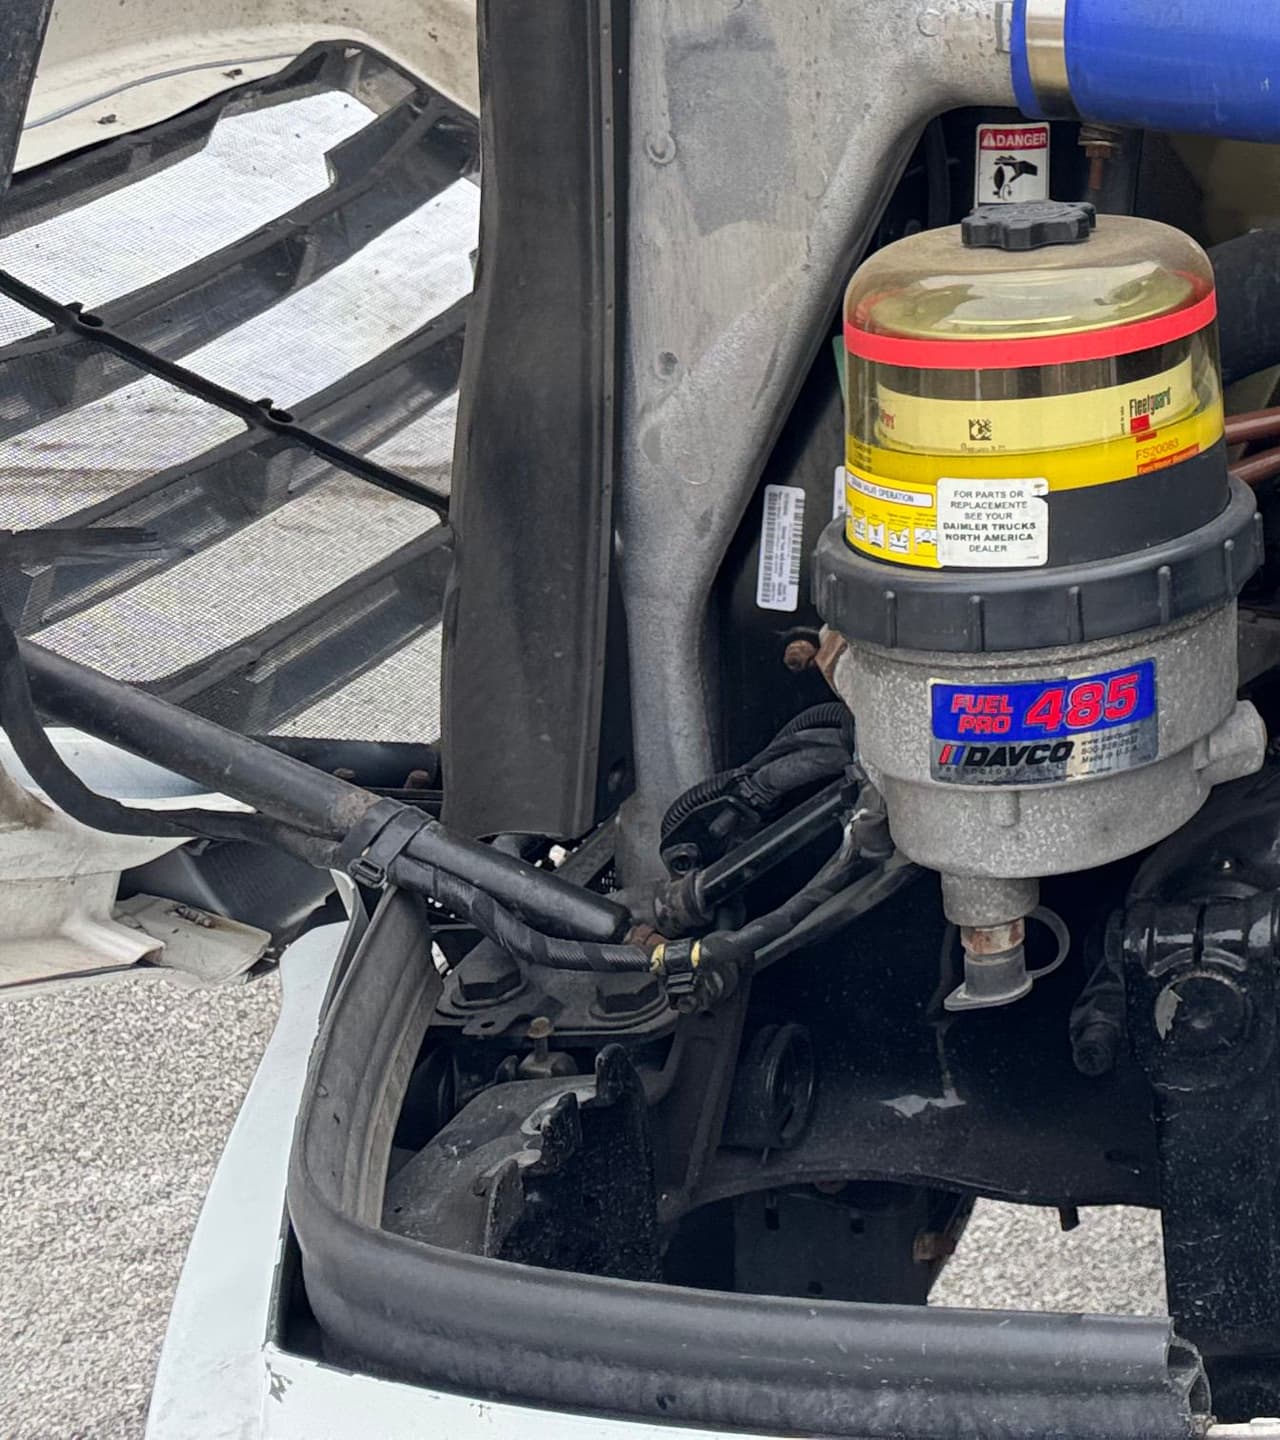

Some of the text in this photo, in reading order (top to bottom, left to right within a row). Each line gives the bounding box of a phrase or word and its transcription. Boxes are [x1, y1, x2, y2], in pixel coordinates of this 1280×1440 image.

[996, 132, 1047, 147] DANGER
[1128, 386, 1171, 418] Fleetguard
[953, 490, 1024, 499] FOR PARTS OR
[964, 512, 1013, 520] SEE YOUR
[943, 522, 1036, 531] DAIMLER TRUCKS
[945, 533, 1034, 542] NORTH AMERICA
[969, 544, 1008, 553] DEALER
[951, 694, 1014, 714] FUEL
[1024, 672, 1140, 731] 485
[958, 715, 1012, 735] PRO
[964, 740, 1075, 767] DAVCO
